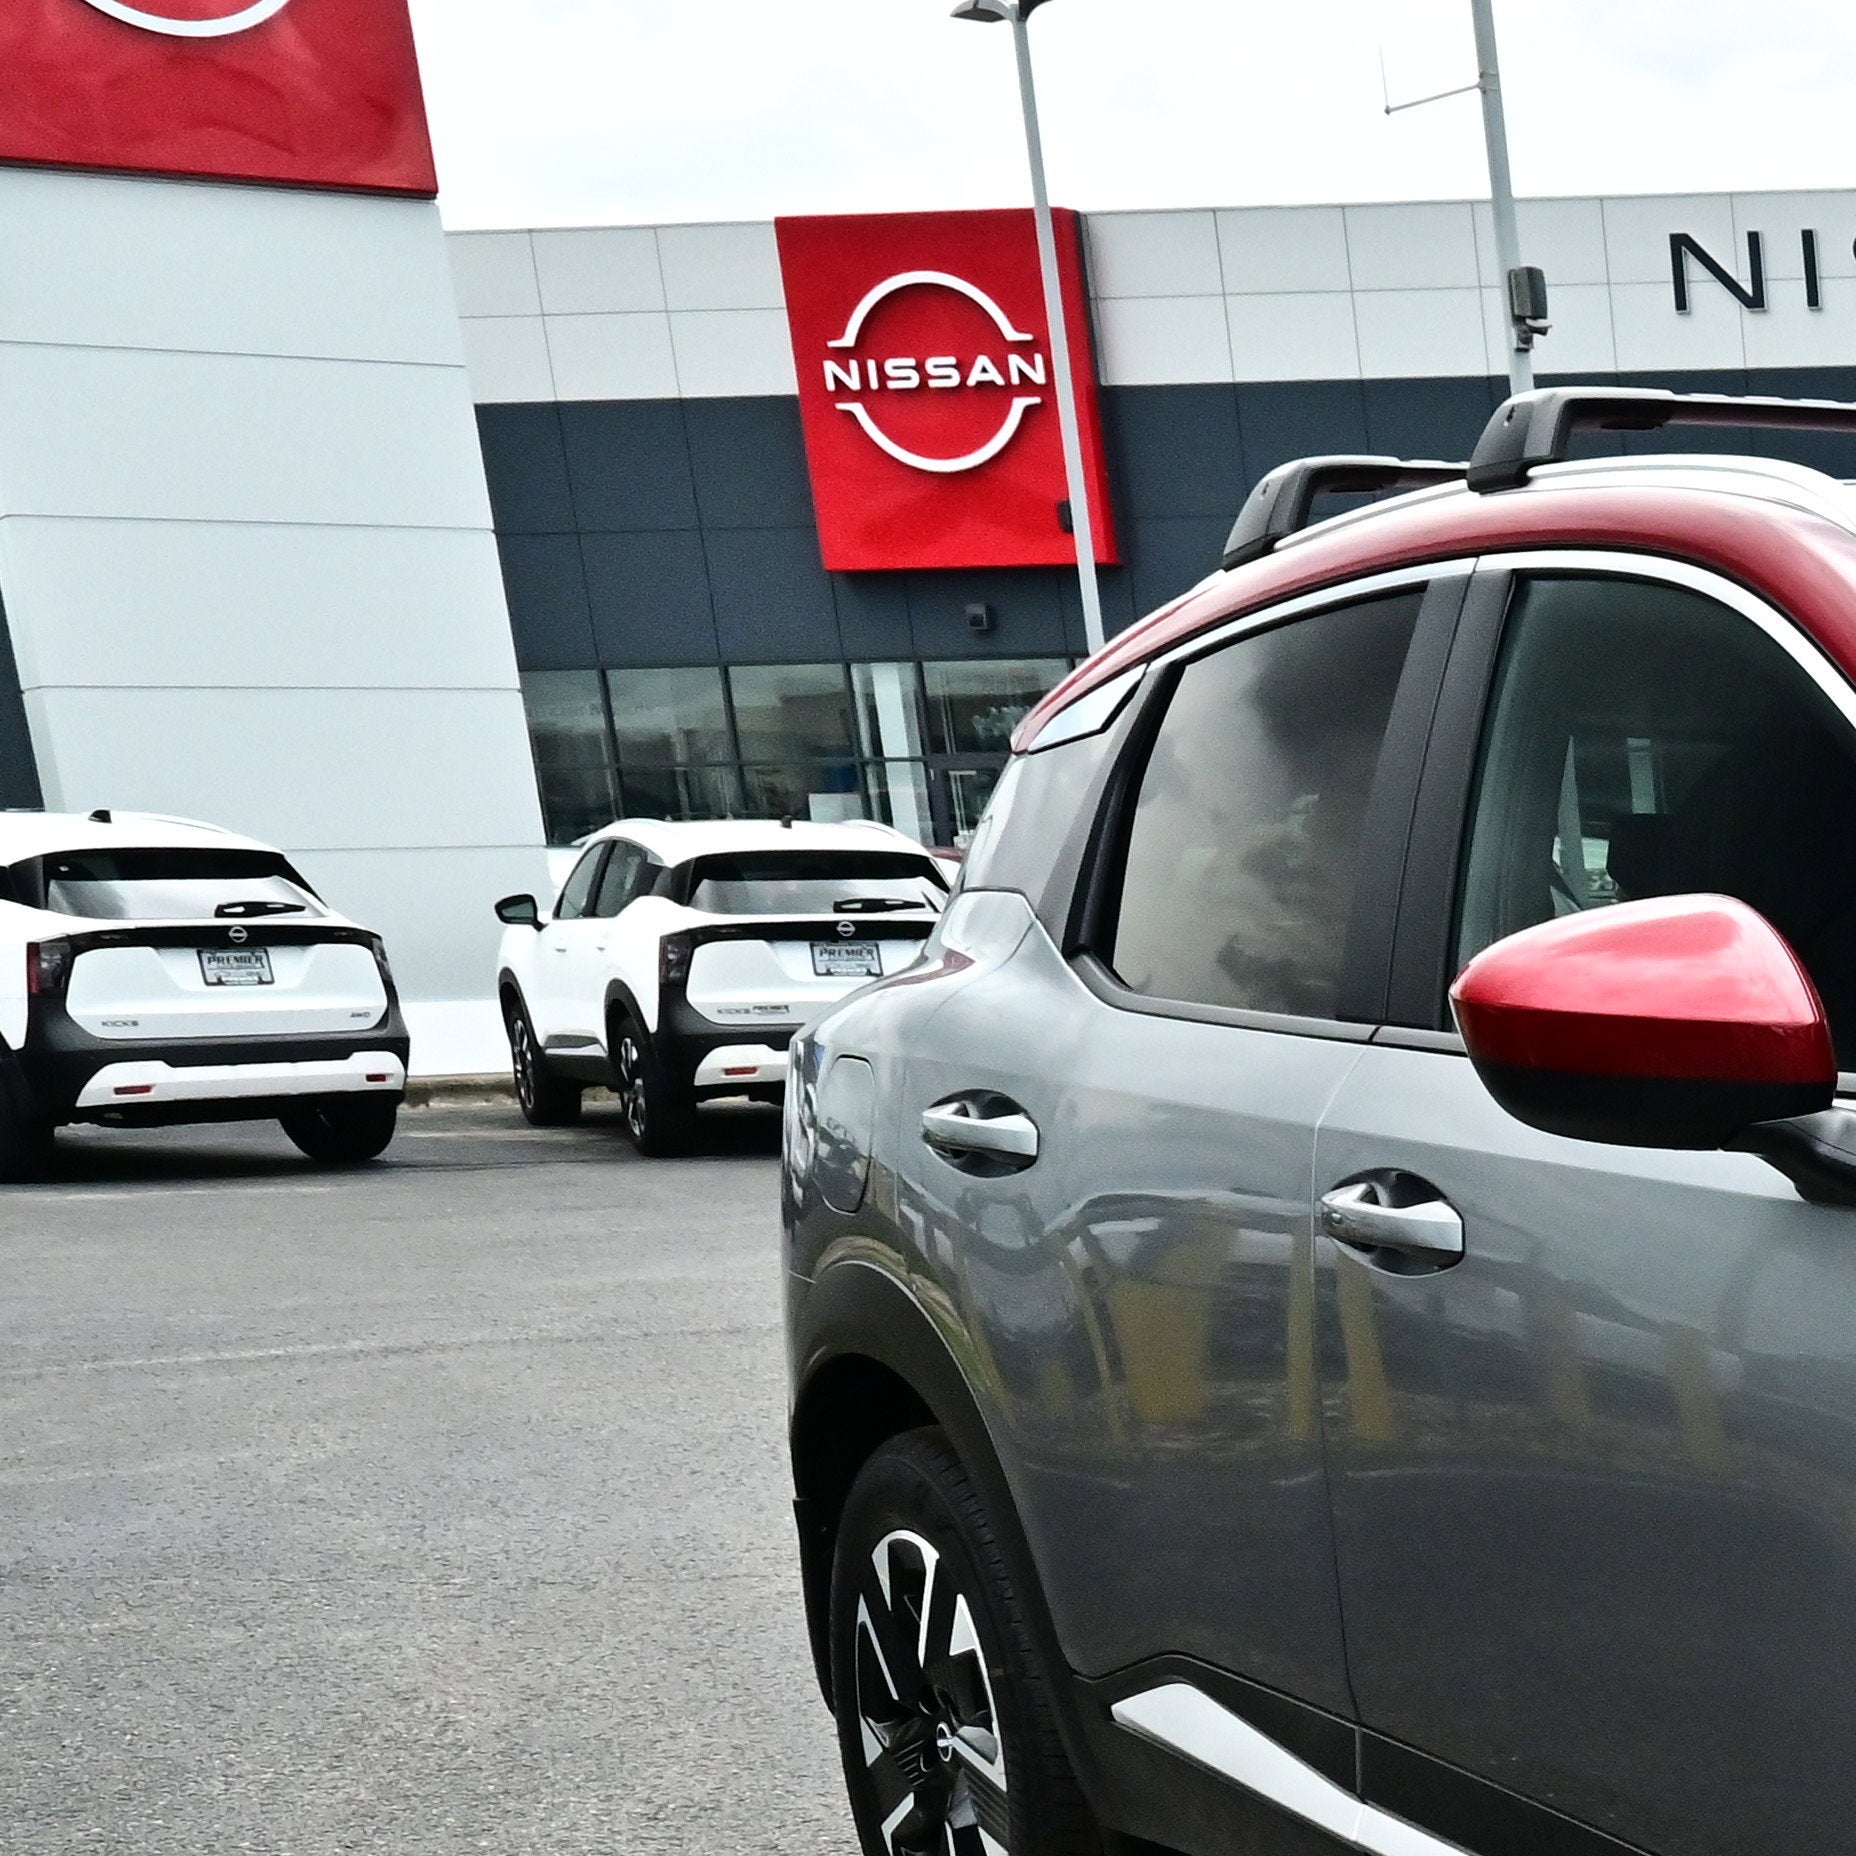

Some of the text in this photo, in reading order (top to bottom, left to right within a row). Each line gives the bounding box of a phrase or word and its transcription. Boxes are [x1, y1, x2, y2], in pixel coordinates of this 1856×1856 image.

[822, 352, 1047, 391] NISSAN
[819, 949, 875, 960] PREMIER
[207, 955, 265, 968] PREMIER
